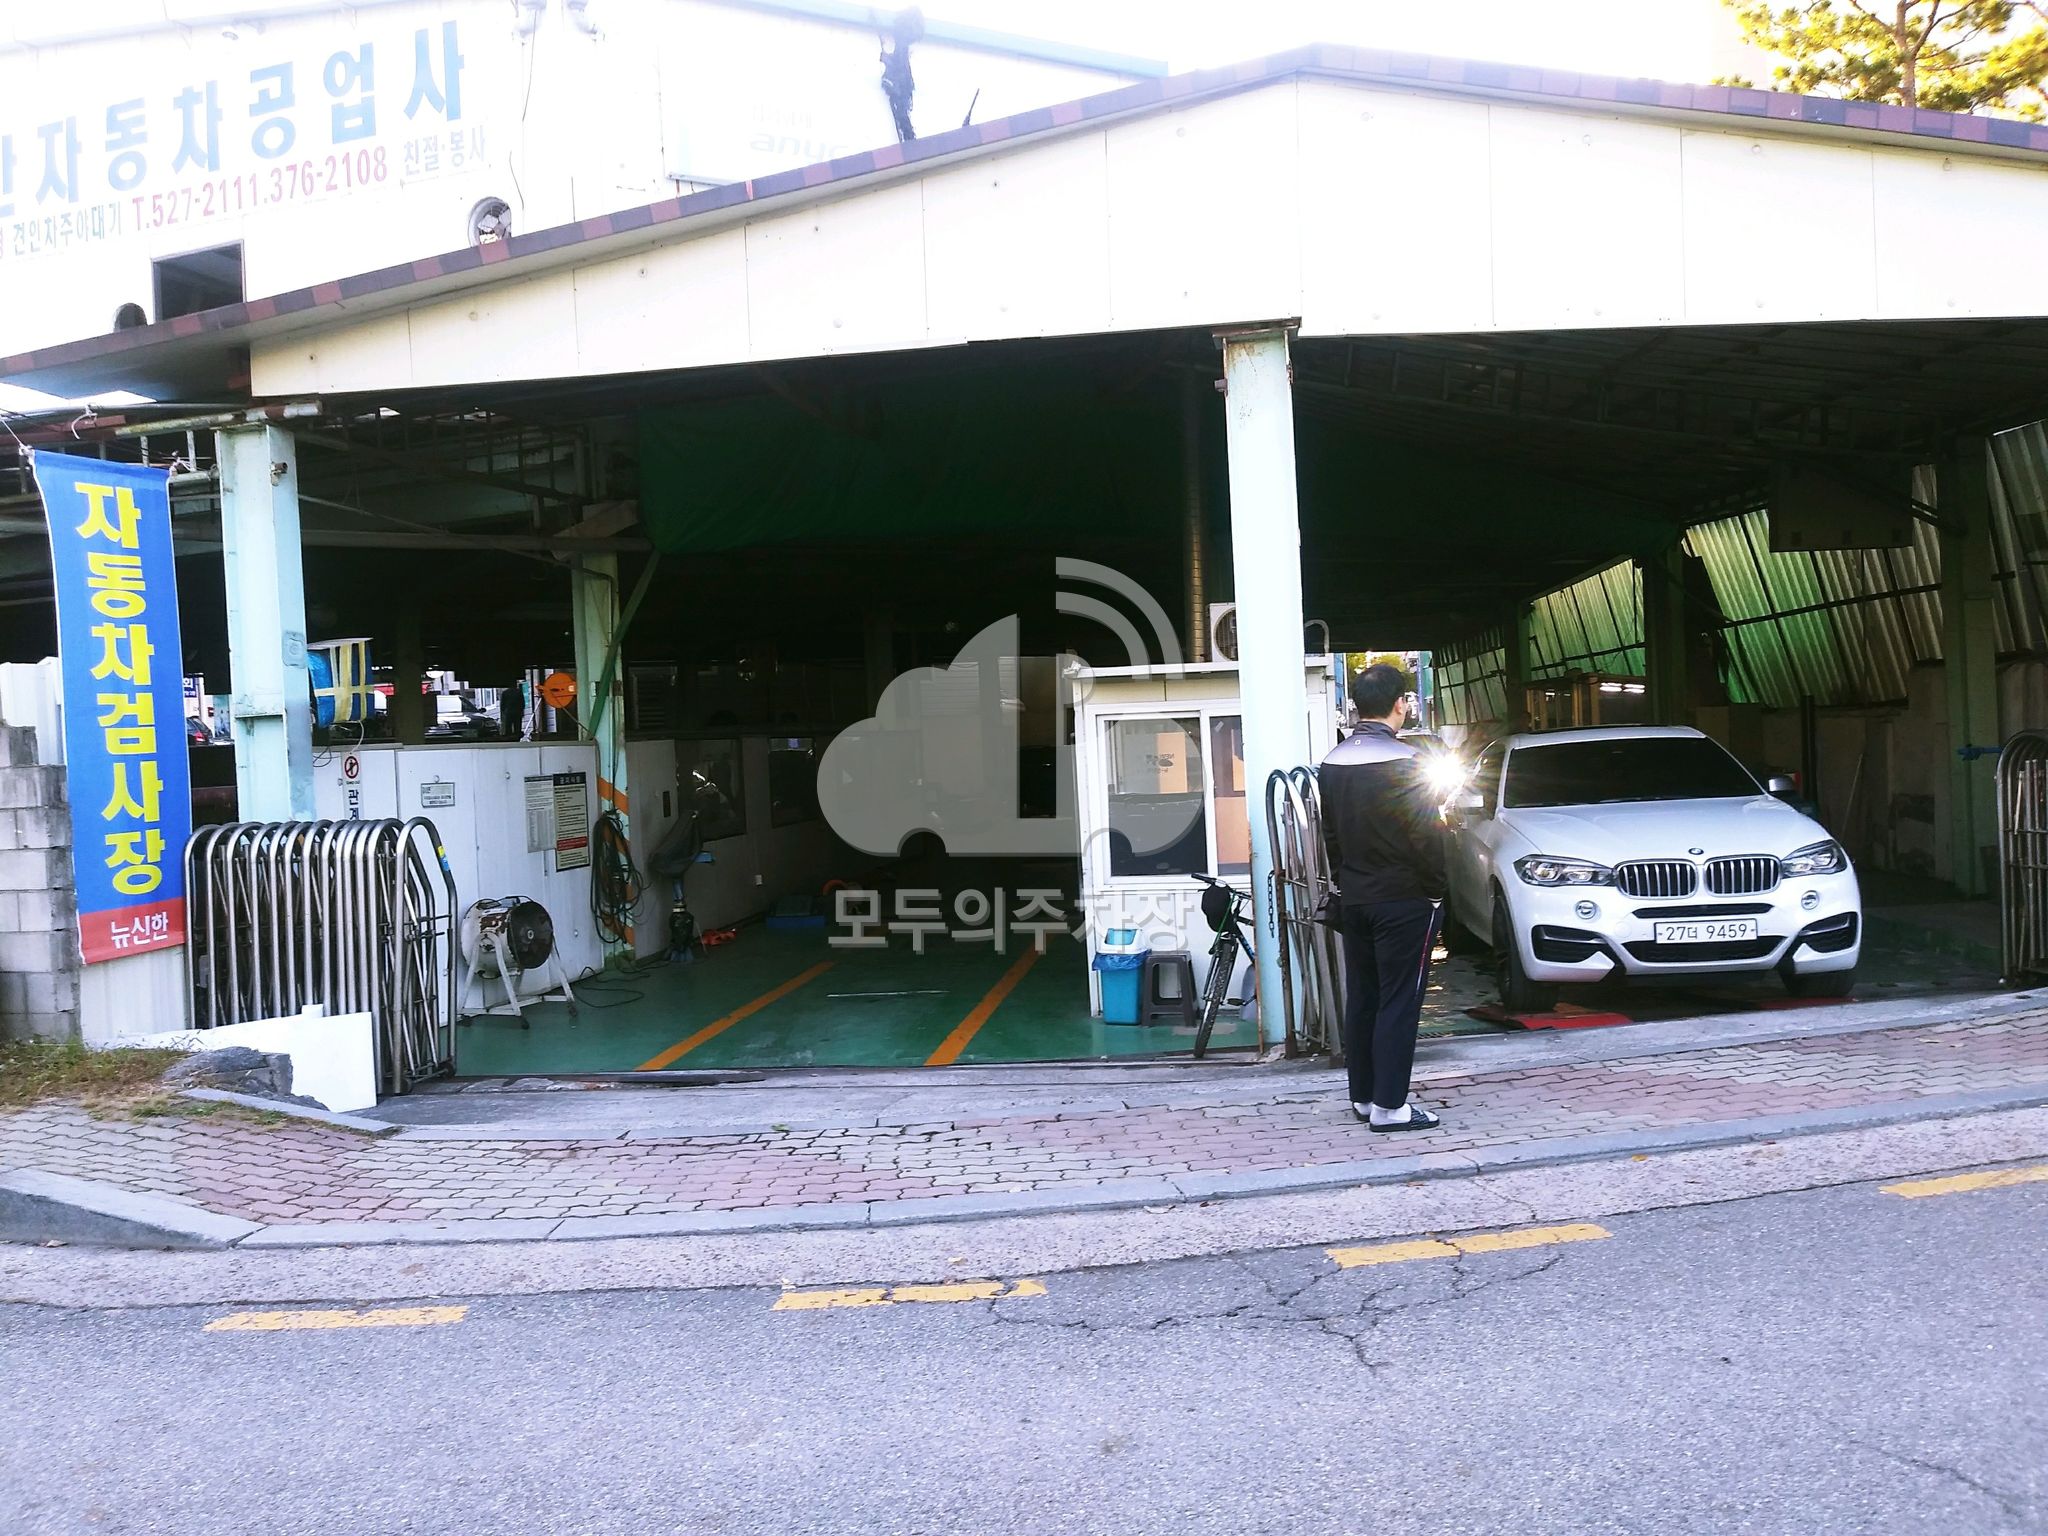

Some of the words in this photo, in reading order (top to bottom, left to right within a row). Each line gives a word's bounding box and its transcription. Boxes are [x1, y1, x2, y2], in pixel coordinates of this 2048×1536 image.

[75, 482, 165, 895] 자동차검사장
[110, 911, 168, 947] 뉴신한
[1706, 923, 1748, 940] 9459
